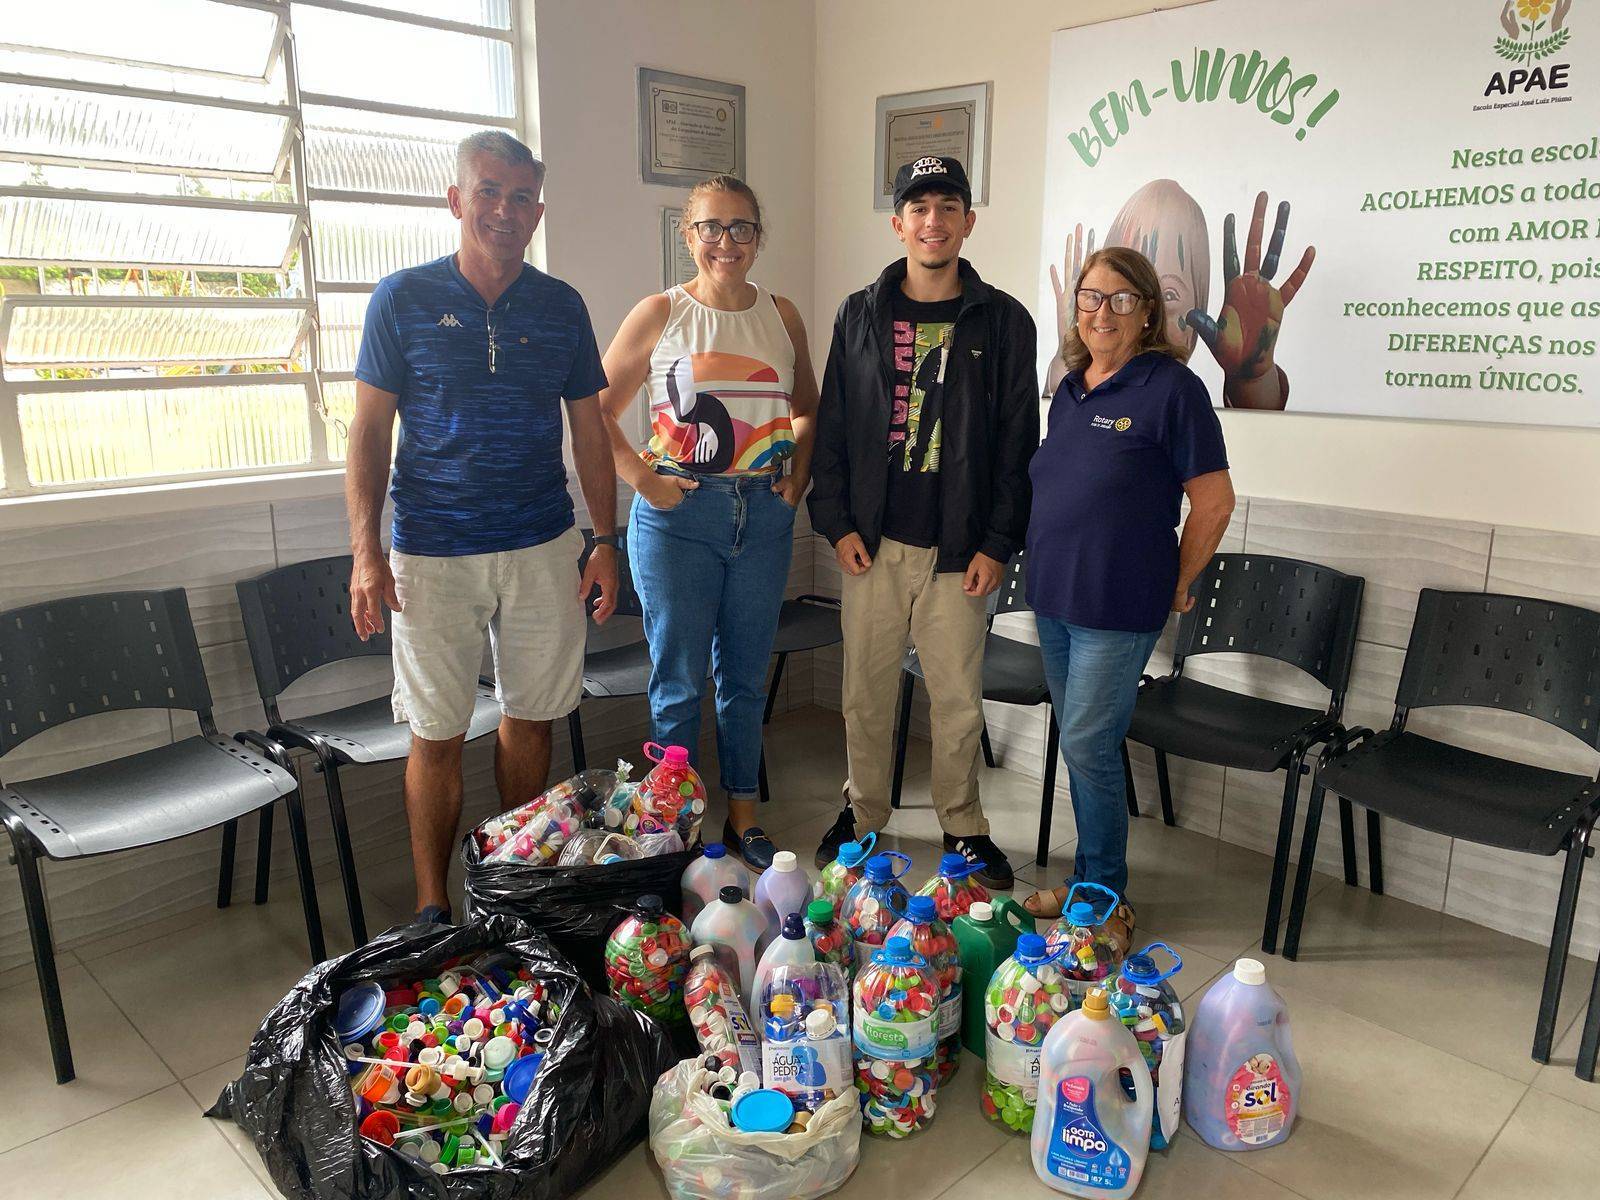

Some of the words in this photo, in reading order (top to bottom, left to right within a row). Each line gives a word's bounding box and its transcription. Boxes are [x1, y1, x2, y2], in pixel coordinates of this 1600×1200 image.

[1484, 64, 1571, 97] APAE
[1067, 46, 1340, 167] BEM-VINDOS!
[1451, 148, 1524, 169] Nesta
[1530, 137, 1600, 163] escol
[911, 166, 948, 180] AUDI
[1360, 183, 1514, 212] ACOLHEMOS
[1520, 187, 1536, 202] a
[1449, 227, 1500, 243] com
[1505, 219, 1589, 241] AMOR
[1417, 259, 1543, 282] RESPEITO,
[1343, 297, 1511, 317] reconhecemos
[1516, 301, 1564, 322] que
[1570, 302, 1600, 318] as
[1387, 333, 1543, 359] DIFERENÇAS
[1548, 339, 1596, 356] nos
[1385, 369, 1472, 389] tornam
[1479, 365, 1584, 394] ÚNICOS.
[1093, 415, 1115, 426] Rotary
[865, 1025, 904, 1042] floresta
[772, 1052, 801, 1066] ÁGUA
[773, 1065, 804, 1076] PEDRA
[1244, 1082, 1276, 1107] sol
[1062, 1128, 1106, 1152] limpa
[1070, 1127, 1095, 1138] GOTA
